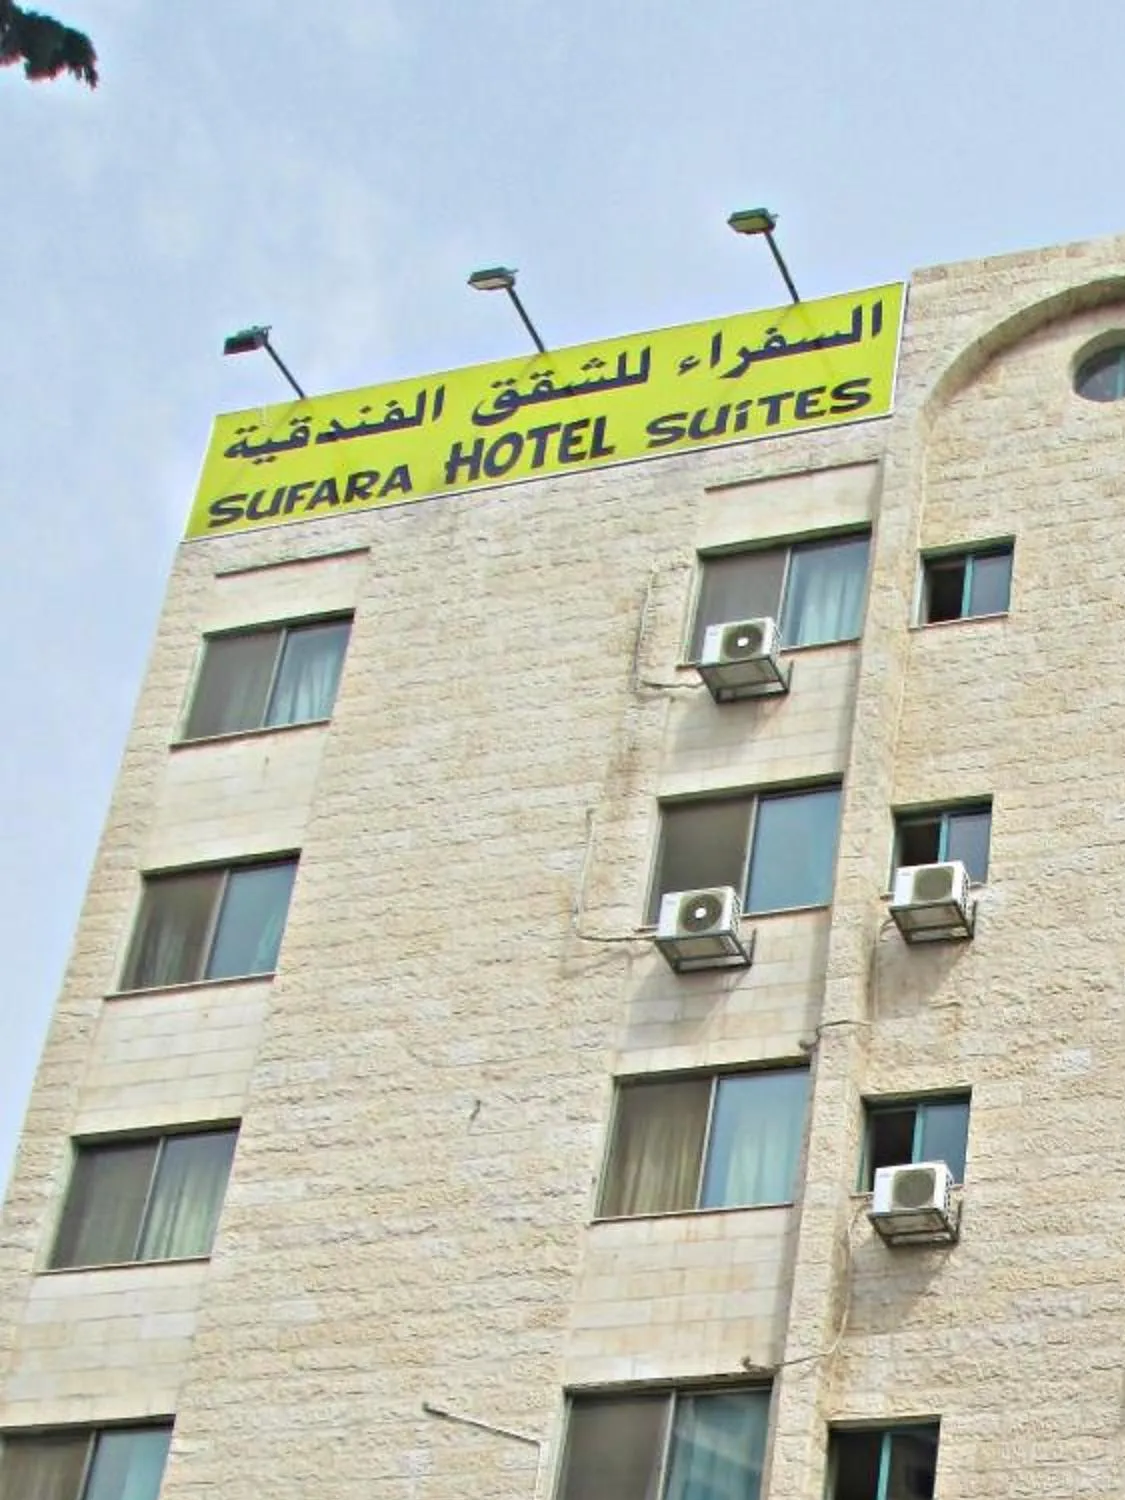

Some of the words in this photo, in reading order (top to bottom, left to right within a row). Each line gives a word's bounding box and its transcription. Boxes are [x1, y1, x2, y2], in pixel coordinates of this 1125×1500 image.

[676, 299, 884, 380] السفراء
[223, 384, 446, 466] الفندقية
[471, 345, 652, 427] للشقق
[207, 463, 413, 529] SUFARA
[444, 415, 616, 485] HOTEL
